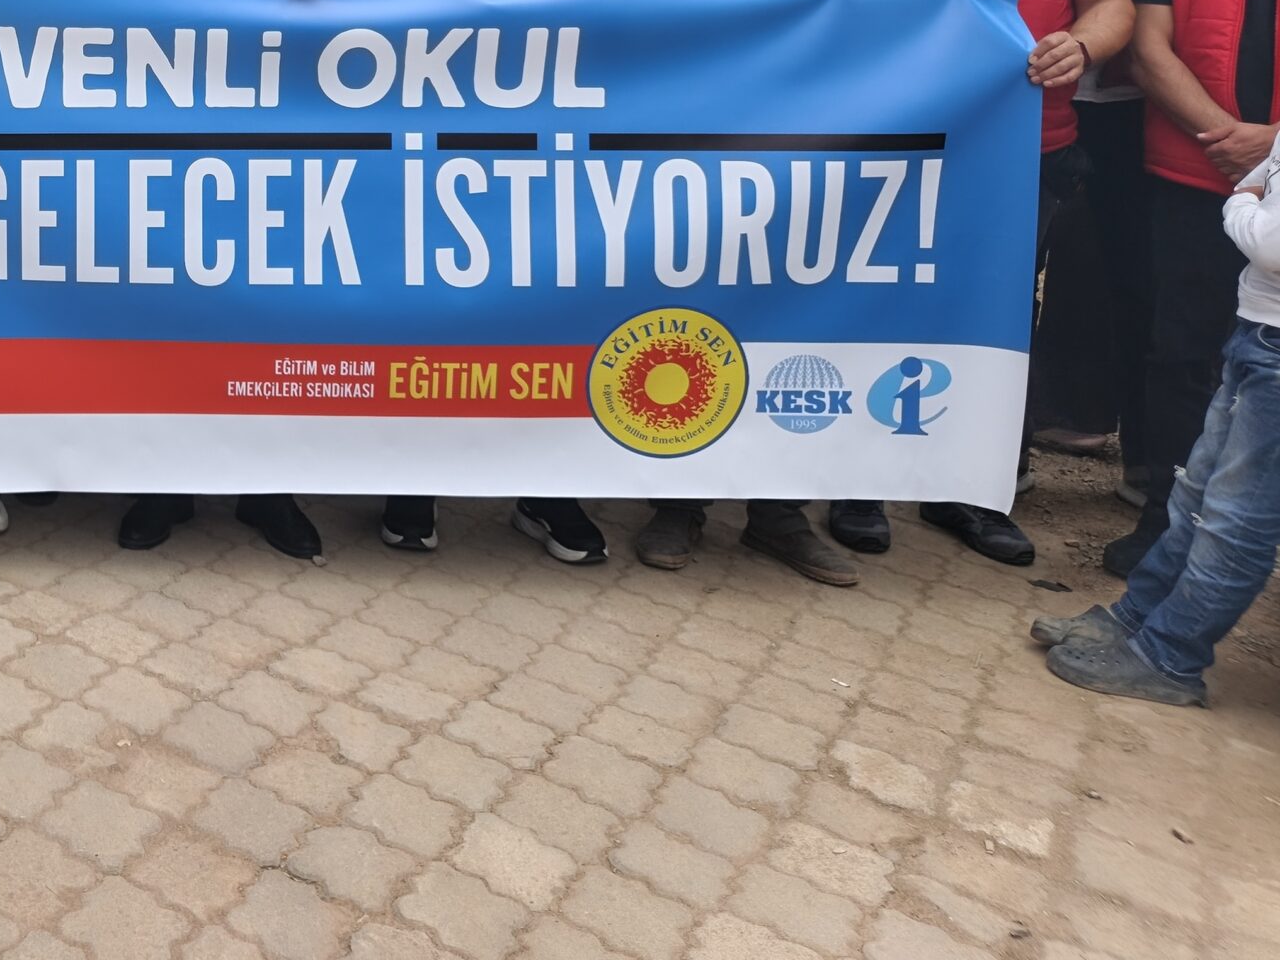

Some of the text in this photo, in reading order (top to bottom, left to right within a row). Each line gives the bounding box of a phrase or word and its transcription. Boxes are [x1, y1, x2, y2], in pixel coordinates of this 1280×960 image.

[318, 27, 605, 108] OKUL
[404, 132, 943, 288] İSTİYORUZ!
[600, 316, 737, 370] EĞİTİM SEN
[321, 363, 336, 375] ve
[509, 362, 573, 400] SEN
[756, 390, 852, 414] KESK
[624, 424, 648, 441] Bilim
[651, 425, 705, 444] Emekçileri
[790, 418, 816, 429] 1995
